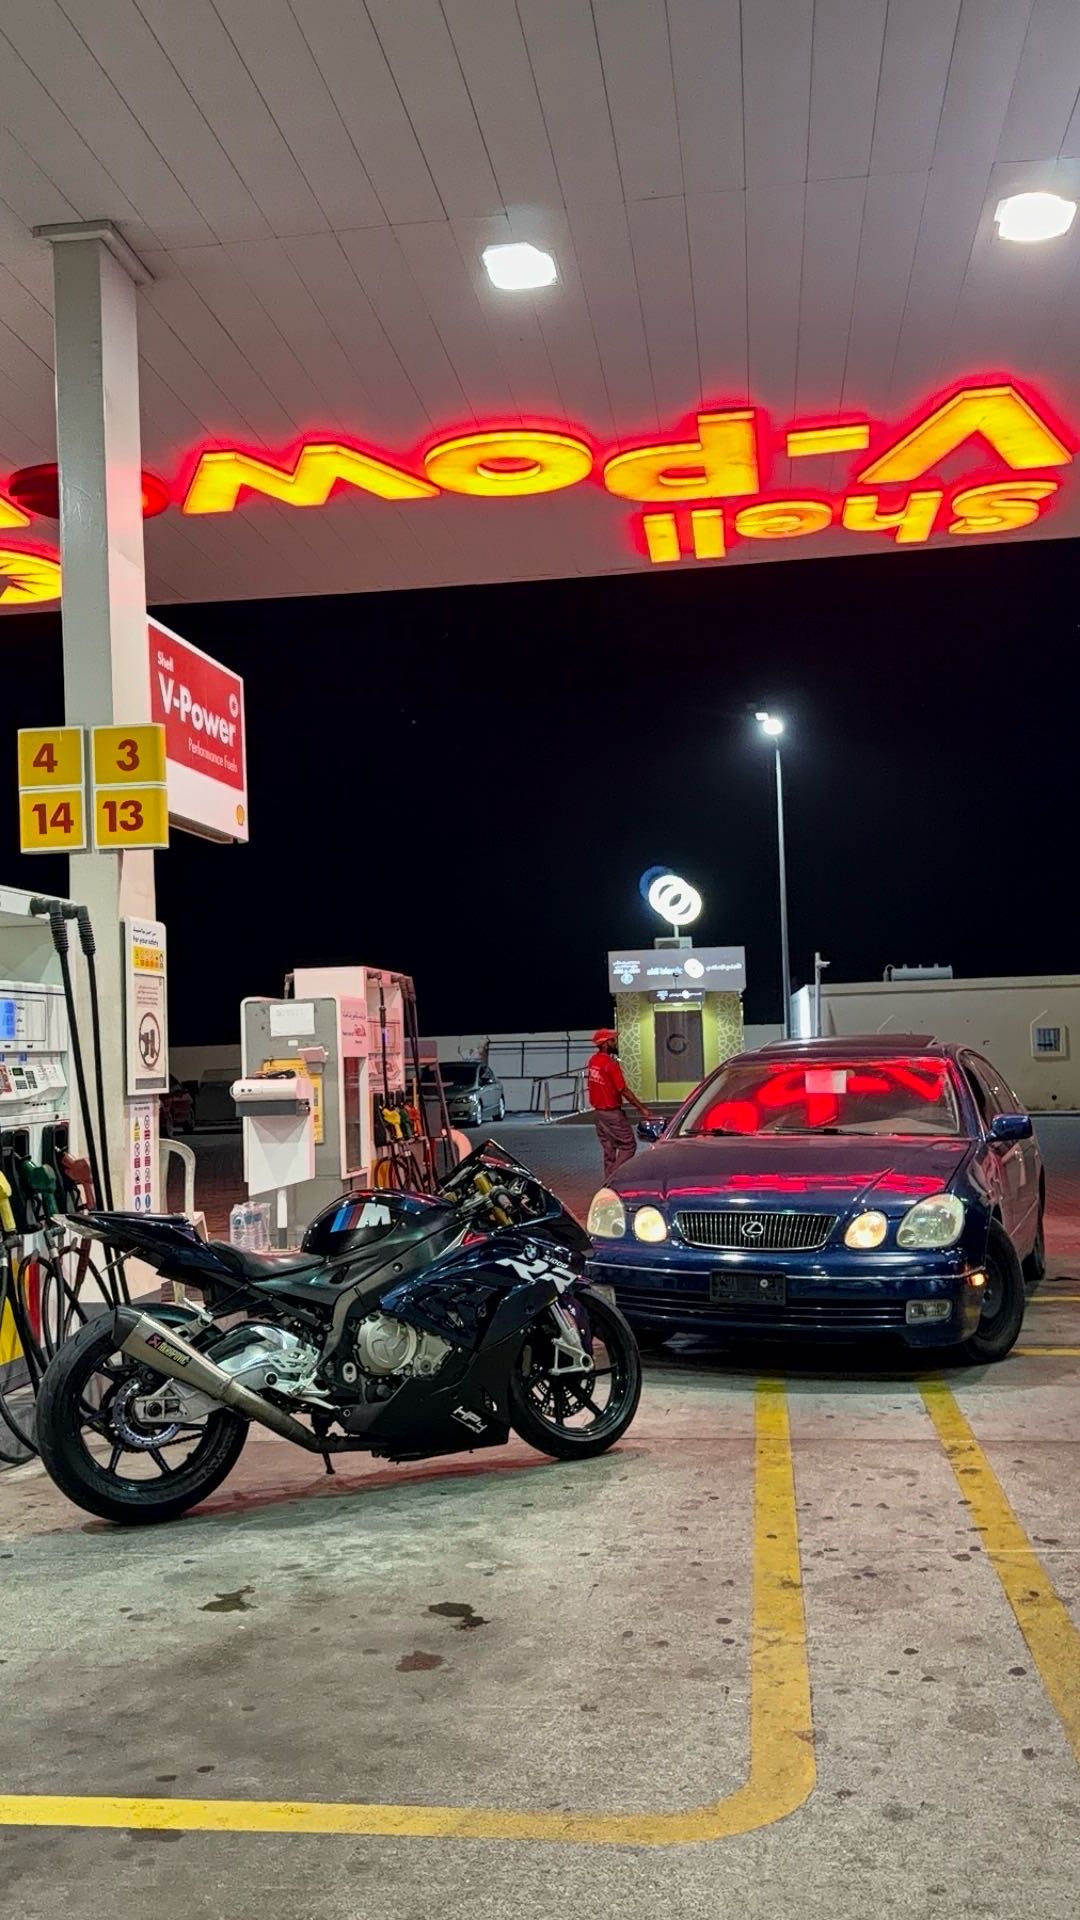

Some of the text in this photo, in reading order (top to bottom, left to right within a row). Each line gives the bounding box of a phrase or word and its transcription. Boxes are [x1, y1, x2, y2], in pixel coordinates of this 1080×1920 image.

[157, 650, 175, 673] Shell
[157, 672, 237, 748] V-Power
[33, 743, 58, 773] 4
[116, 739, 140, 771] 3
[188, 737, 224, 767] Performance
[32, 802, 74, 834] 14
[102, 800, 144, 832] 13
[452, 1405, 488, 1432] HP4
